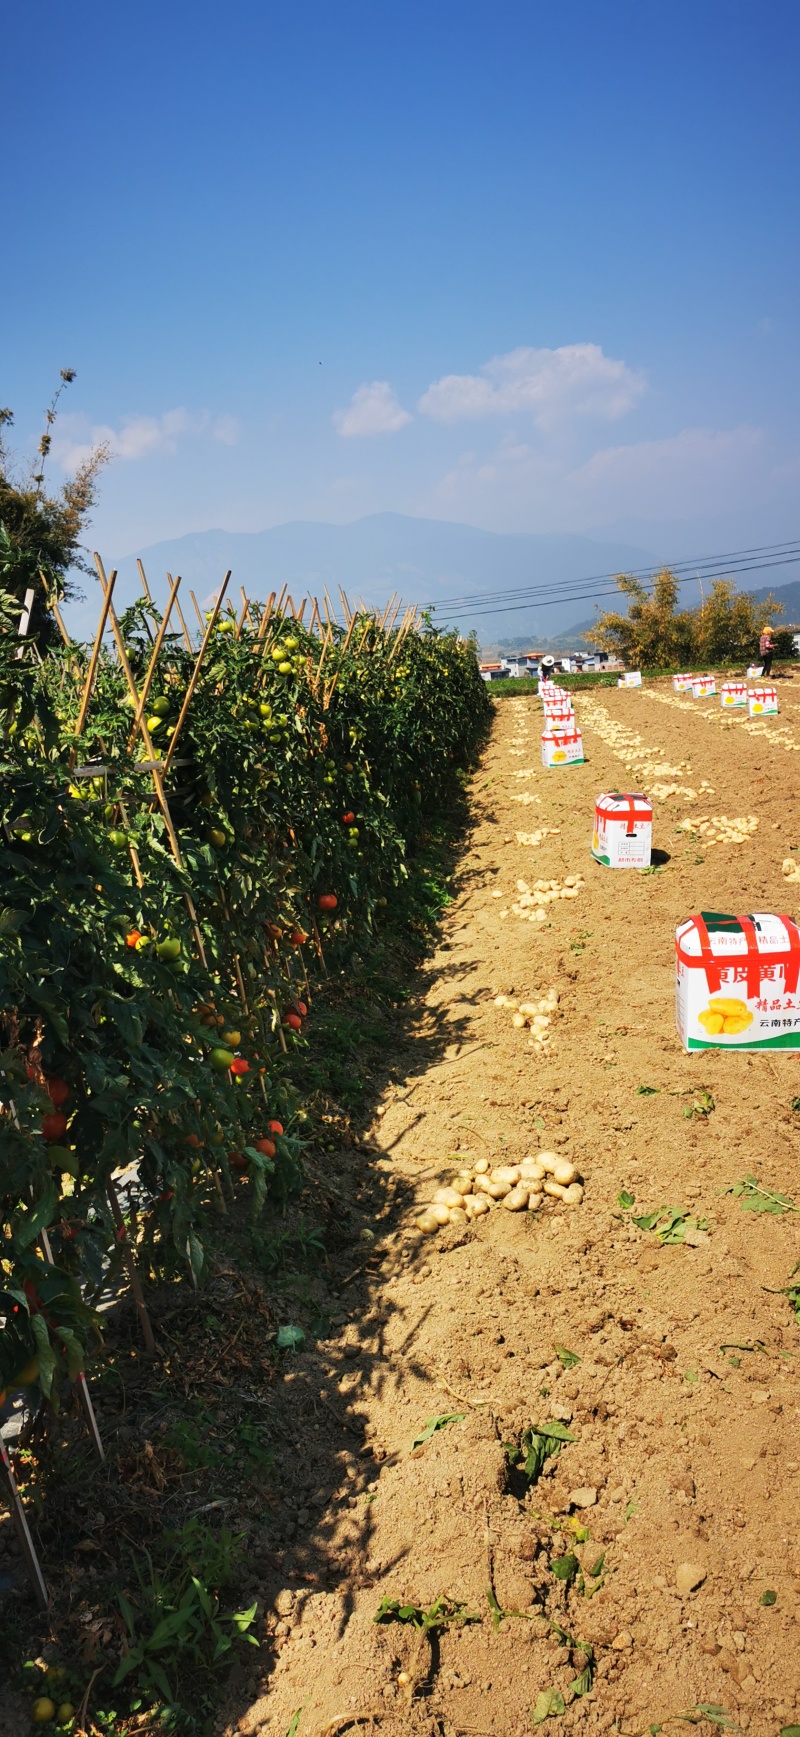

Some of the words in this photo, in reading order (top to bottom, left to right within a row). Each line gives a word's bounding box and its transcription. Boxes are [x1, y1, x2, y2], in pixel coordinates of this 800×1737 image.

[717, 963, 789, 984] 黄皮黄
[755, 998, 800, 1013] 精品土
